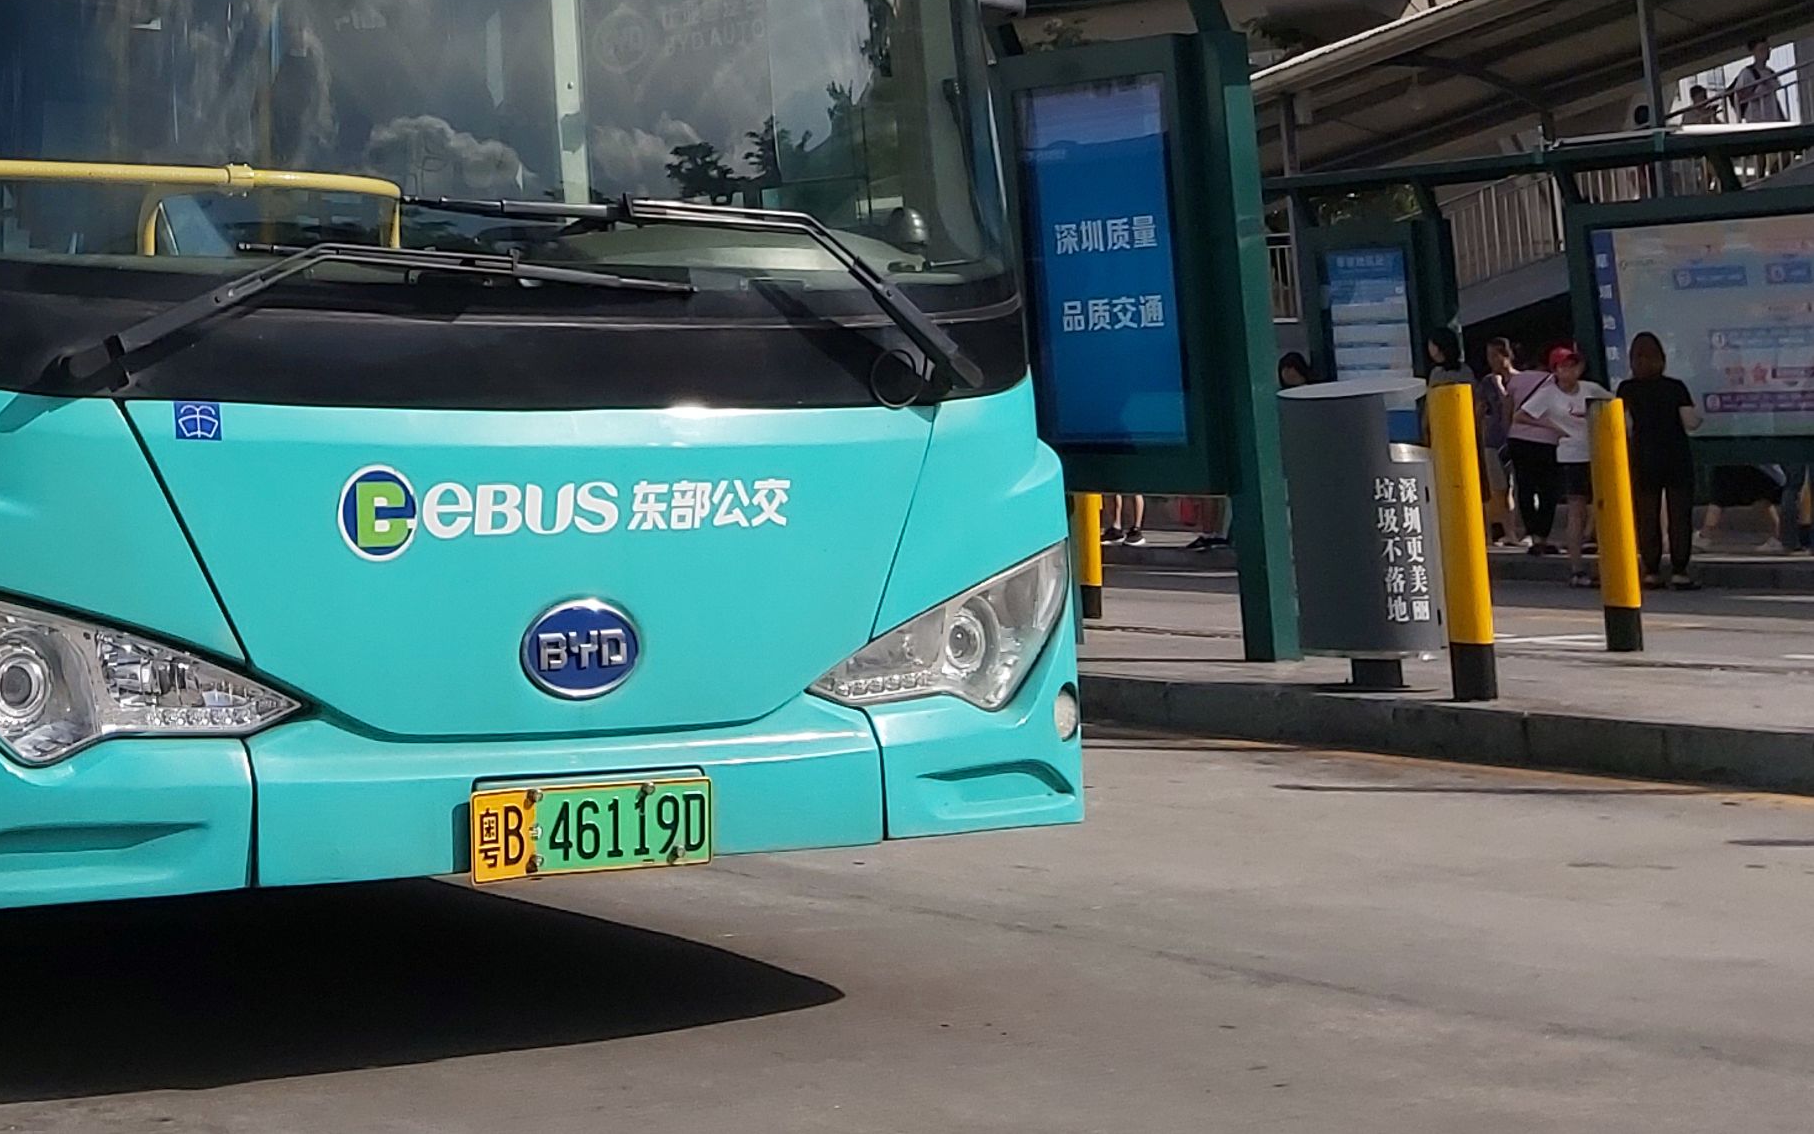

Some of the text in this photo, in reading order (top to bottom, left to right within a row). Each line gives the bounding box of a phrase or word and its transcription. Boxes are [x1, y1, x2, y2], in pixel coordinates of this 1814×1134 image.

[1054, 215, 1158, 255] 深圳质量
[1062, 294, 1165, 332] 品质交通
[627, 478, 792, 531] 东部公交
[1373, 477, 1410, 622] 垃圾不落地
[1398, 477, 1431, 622] 深圳更美丽
[538, 627, 629, 672] BYD
[478, 790, 706, 868] 粤B 46119D
